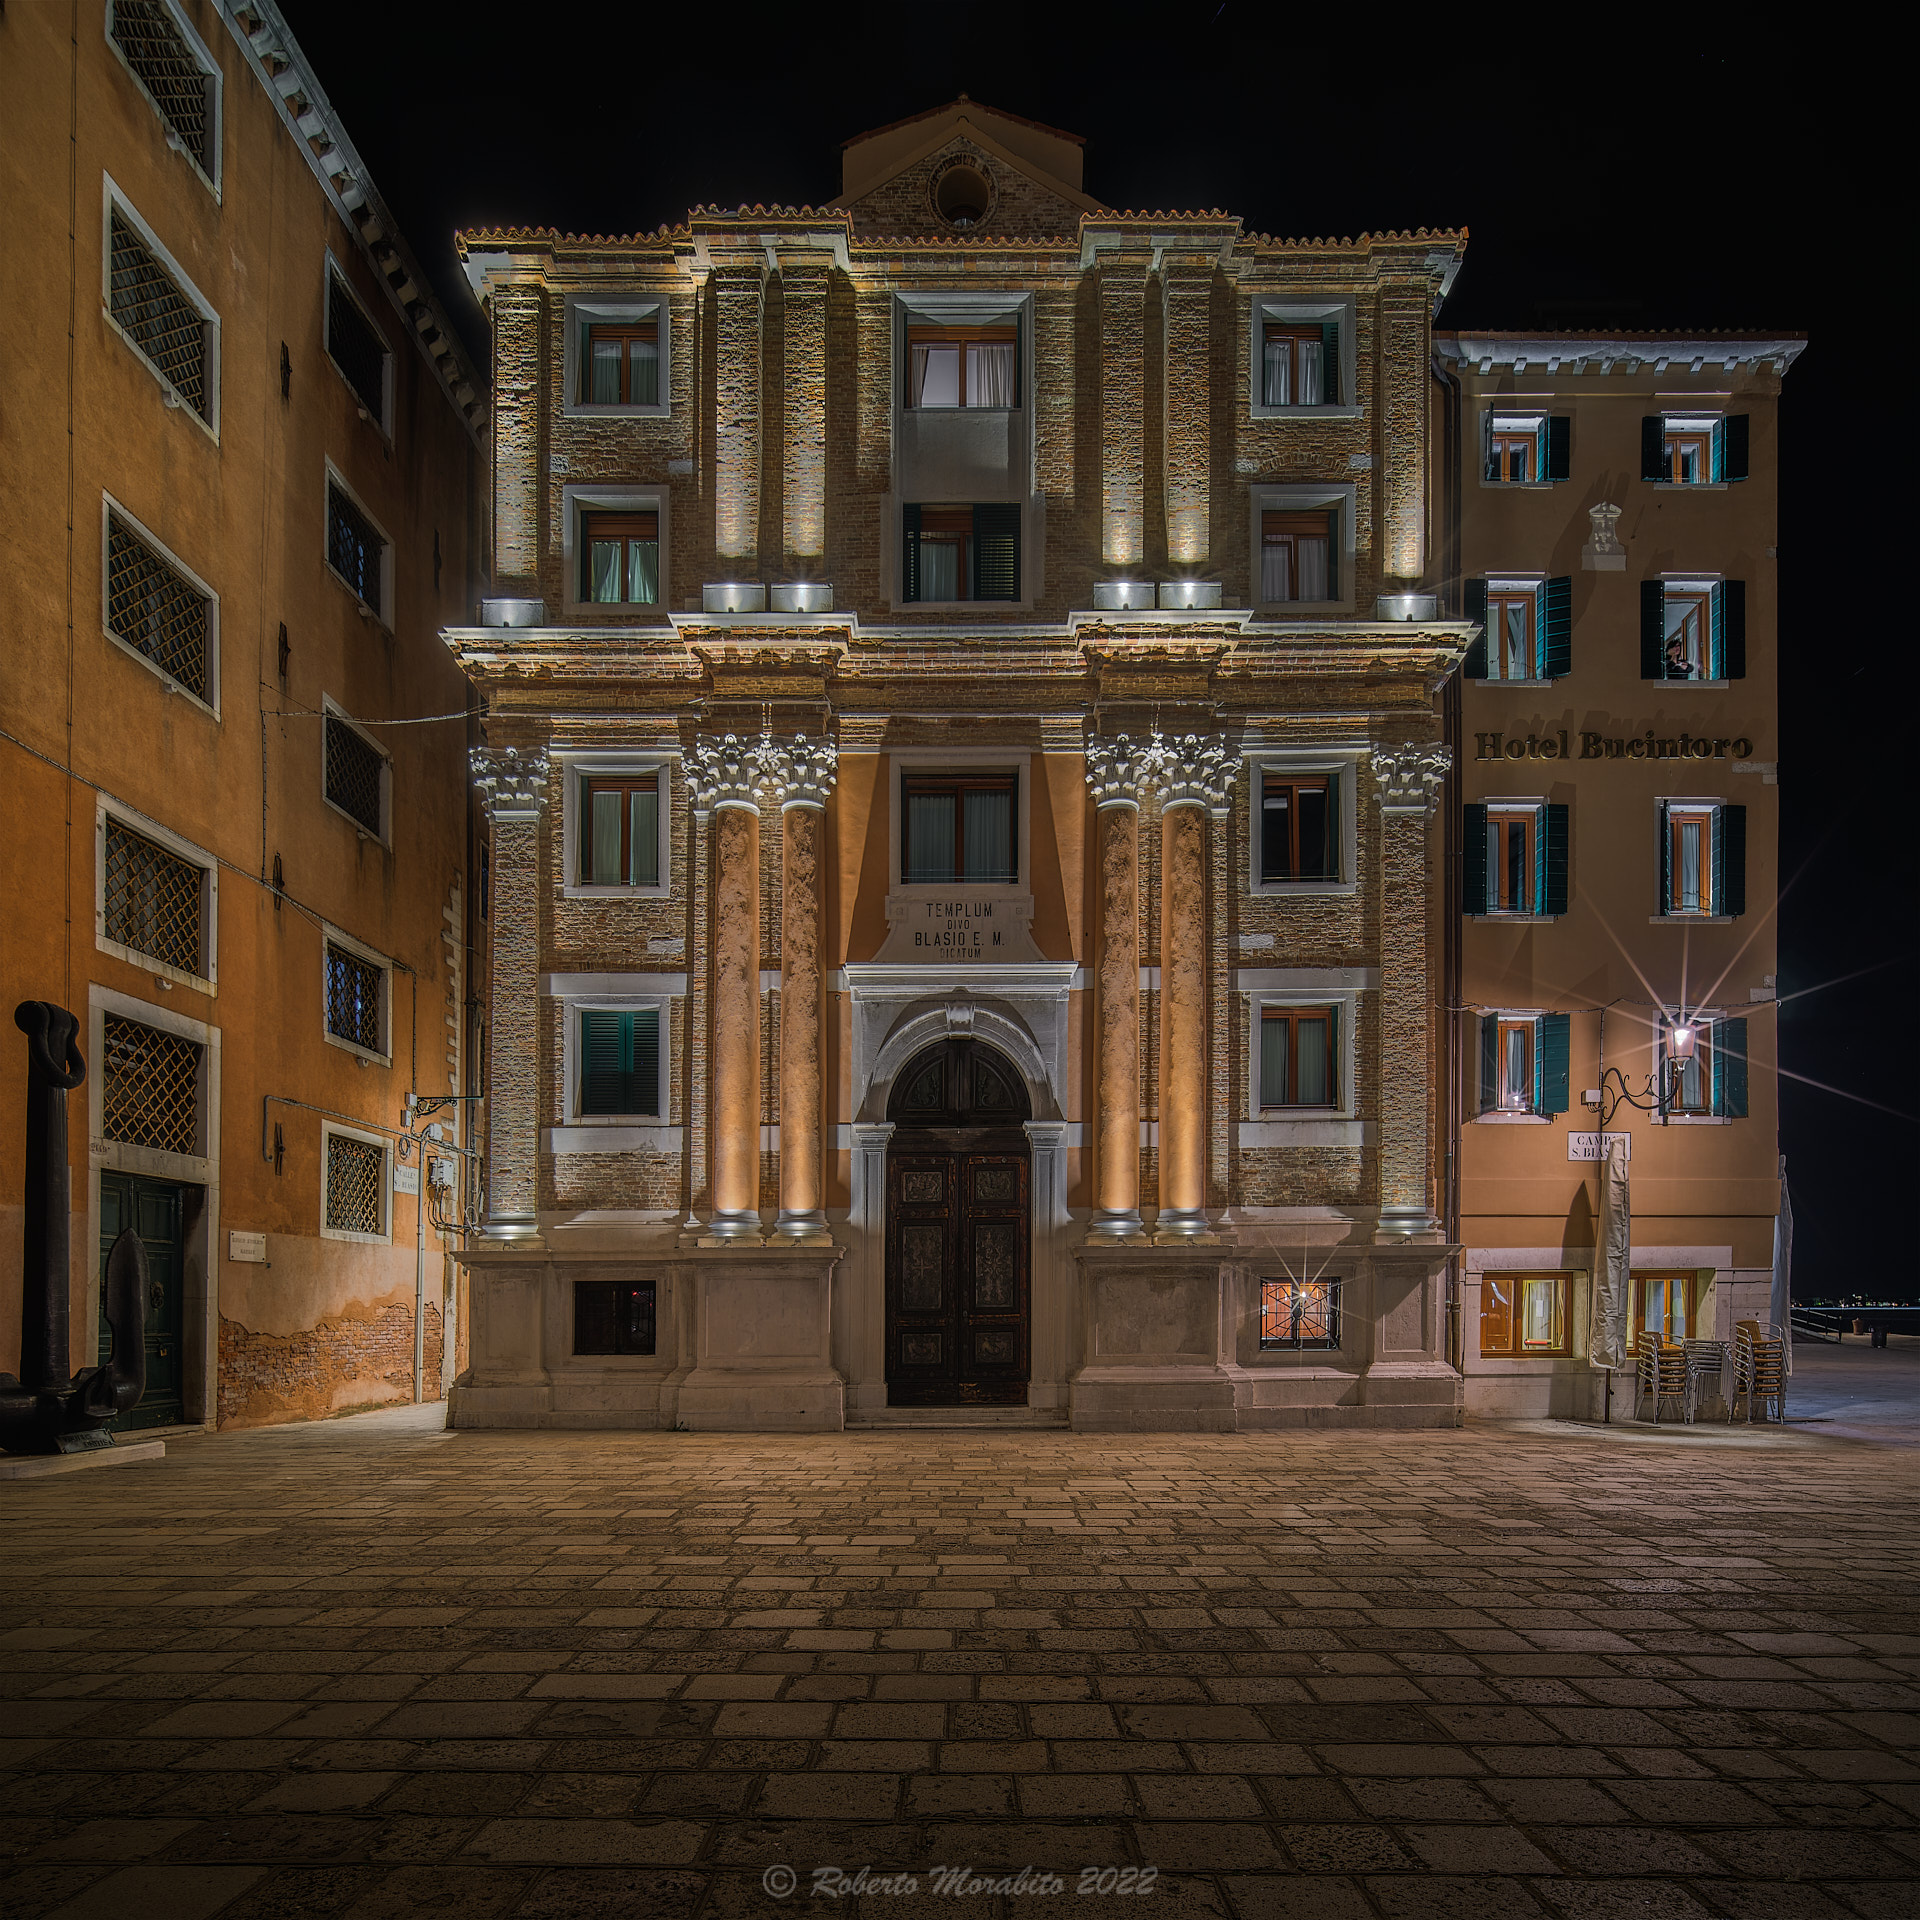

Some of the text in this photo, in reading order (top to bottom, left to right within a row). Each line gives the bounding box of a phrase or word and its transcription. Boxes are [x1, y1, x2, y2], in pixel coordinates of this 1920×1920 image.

[1474, 730, 1754, 761] Hotel Bucintoro
[926, 903, 992, 918] TEMPLUM
[947, 919, 970, 930] DIVO
[915, 932, 1005, 946] BLASIO E. M.
[940, 948, 981, 958] DICATUM
[1577, 1135, 1619, 1146] CAMP
[1571, 1148, 1581, 1158] S.
